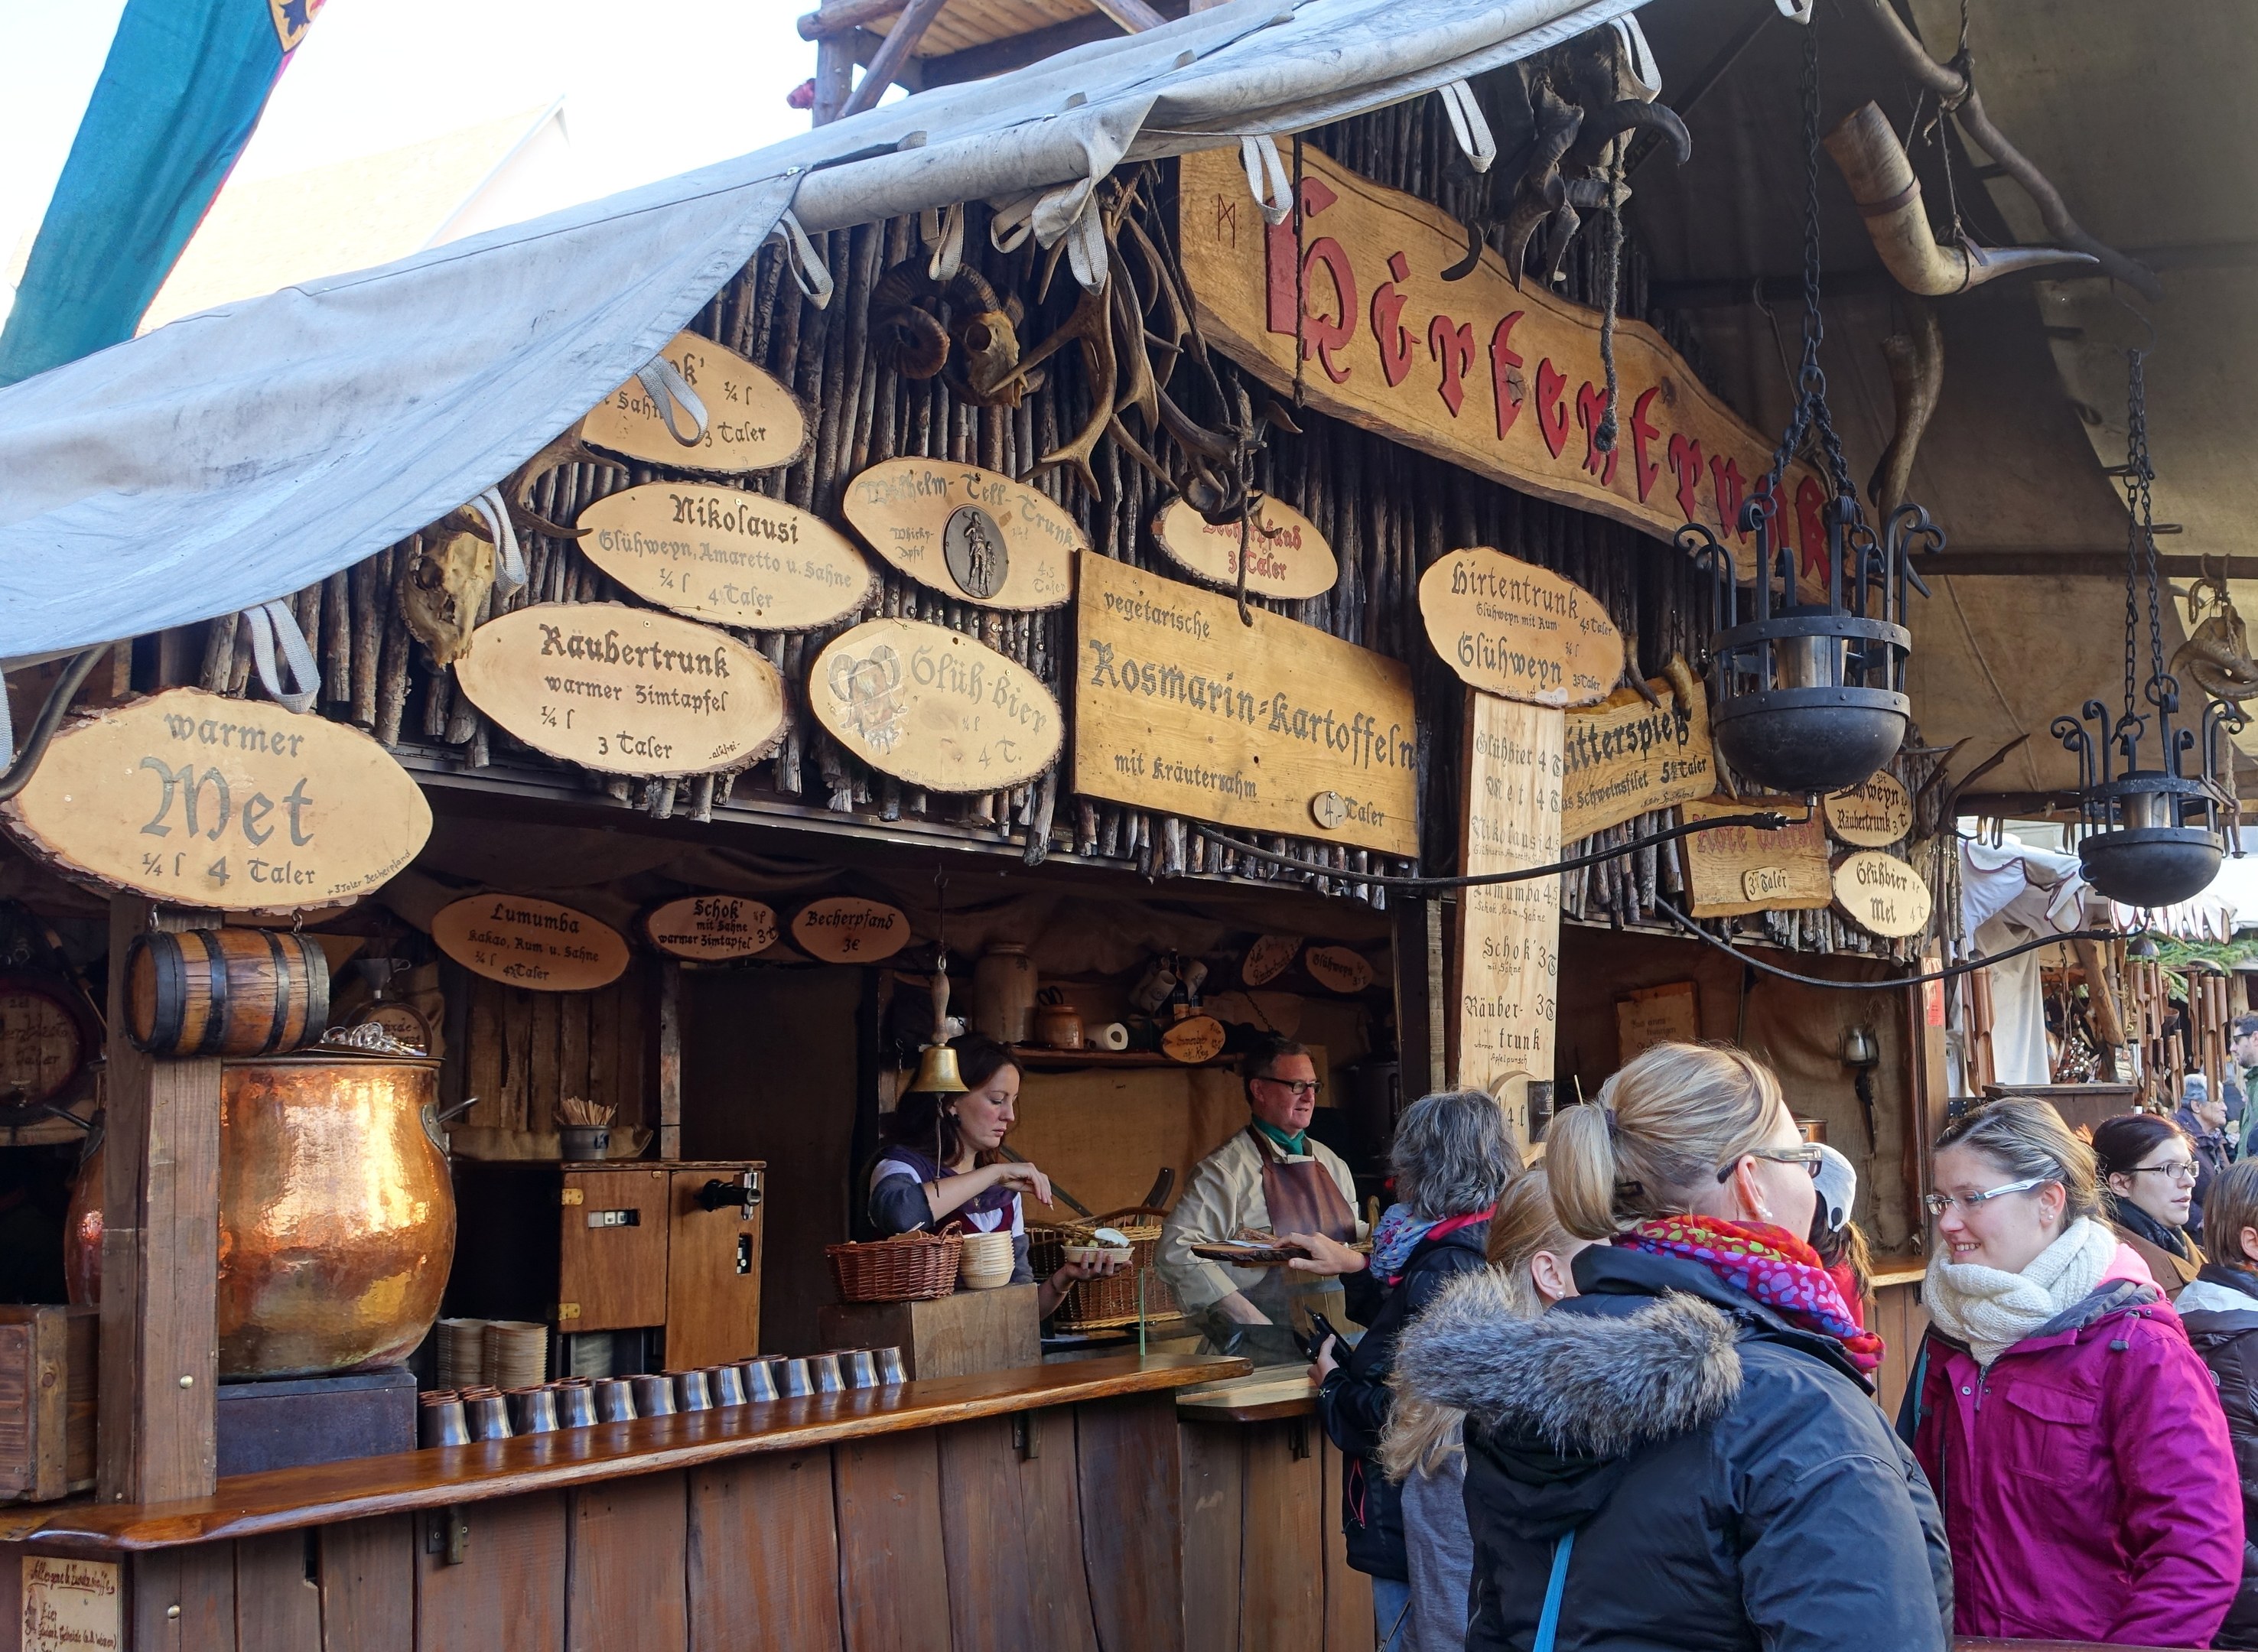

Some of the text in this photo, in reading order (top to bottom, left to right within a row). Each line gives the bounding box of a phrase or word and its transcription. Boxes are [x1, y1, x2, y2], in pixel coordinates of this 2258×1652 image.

[1265, 177, 1830, 589] Hirtentrunk
[717, 421, 766, 443] Taler
[669, 493, 799, 544] Nikolausi
[699, 541, 780, 574] Amaretto
[786, 560, 802, 577] u.
[804, 562, 851, 588] Sahne
[1228, 546, 1287, 580] 3 Taler
[724, 583, 773, 609] Taler
[1033, 578, 1066, 595] Taler
[1451, 560, 1579, 620] Hirtentrunk
[1104, 589, 1211, 640] vegetarische
[1476, 601, 1557, 631] Glühweyn mit Rum
[1590, 617, 1612, 636] Taler
[538, 623, 730, 678] Räubertrunk
[1457, 631, 1563, 690] Glühweyn
[544, 675, 729, 717] warmer Zimtapfel
[1580, 674, 1601, 691] Taler
[164, 712, 305, 759] warmer
[597, 730, 672, 760] 3 Taler
[978, 745, 991, 770] 4
[1476, 730, 1533, 767] Glühbier
[1537, 750, 1547, 772] 4
[1114, 748, 1258, 798] mit Kräuterrahm
[1678, 756, 1707, 778] Taler
[139, 756, 315, 847] Met
[1536, 788, 1545, 811] 4
[1562, 770, 1648, 811] us Schweinsfilet
[1345, 795, 1384, 827] Taler
[1837, 809, 1891, 833] Räubertrunk
[1892, 821, 1898, 835] 3
[1471, 815, 1543, 854] Nikolausi
[208, 856, 315, 886] 4 Taler
[364, 849, 411, 884] Becherpfand
[1760, 868, 1787, 893] Taler
[1856, 857, 1908, 892] Glühbier
[490, 902, 580, 935] Lumumba
[805, 909, 896, 931] Becherpfand
[1870, 897, 1897, 924] Met
[658, 934, 698, 945] warmer
[701, 934, 753, 951] Zimtapfel
[756, 929, 766, 944] 3
[696, 919, 748, 935] mit Sahne
[467, 929, 599, 964] Kakao, Rum u. Sahne
[843, 938, 861, 952] 3€
[515, 962, 549, 981] Taler
[1313, 954, 1353, 978] Glühweyn
[1498, 963, 1521, 976] Sahne
[1464, 995, 1523, 1019] Räuber-
[1499, 1027, 1540, 1051] trunk
[1491, 1053, 1528, 1070] Apfelpunsch
